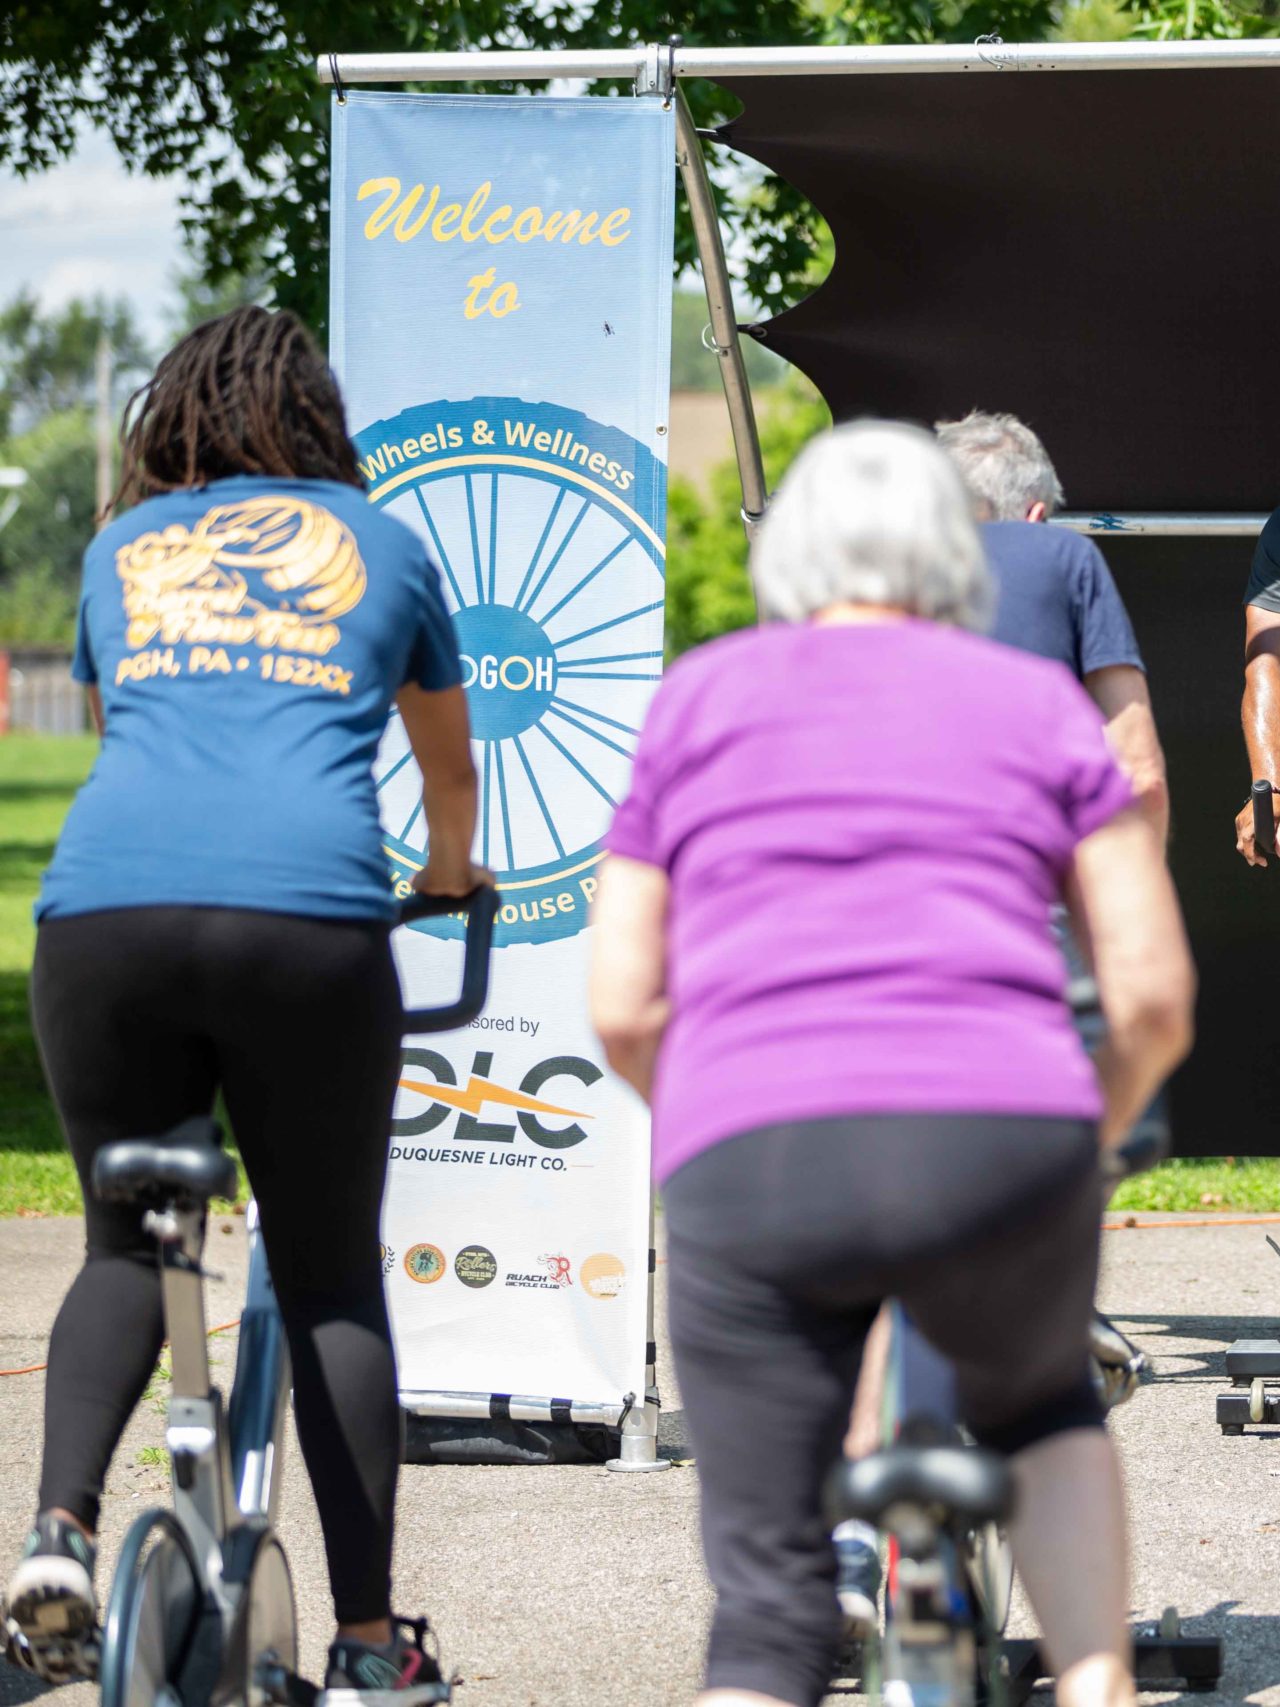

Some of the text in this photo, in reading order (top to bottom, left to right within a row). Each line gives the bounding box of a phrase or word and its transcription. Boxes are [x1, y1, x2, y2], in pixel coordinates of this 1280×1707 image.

[357, 176, 631, 246] Welcome
[464, 267, 521, 320] to
[358, 419, 635, 490] Wheels & Wellness
[188, 646, 232, 674] PA
[458, 654, 553, 692] OGOH
[468, 1016, 540, 1037] sored by
[389, 1147, 568, 1171] DUQUESNE LIGHT CO.
[506, 1273, 547, 1282] RUACH
